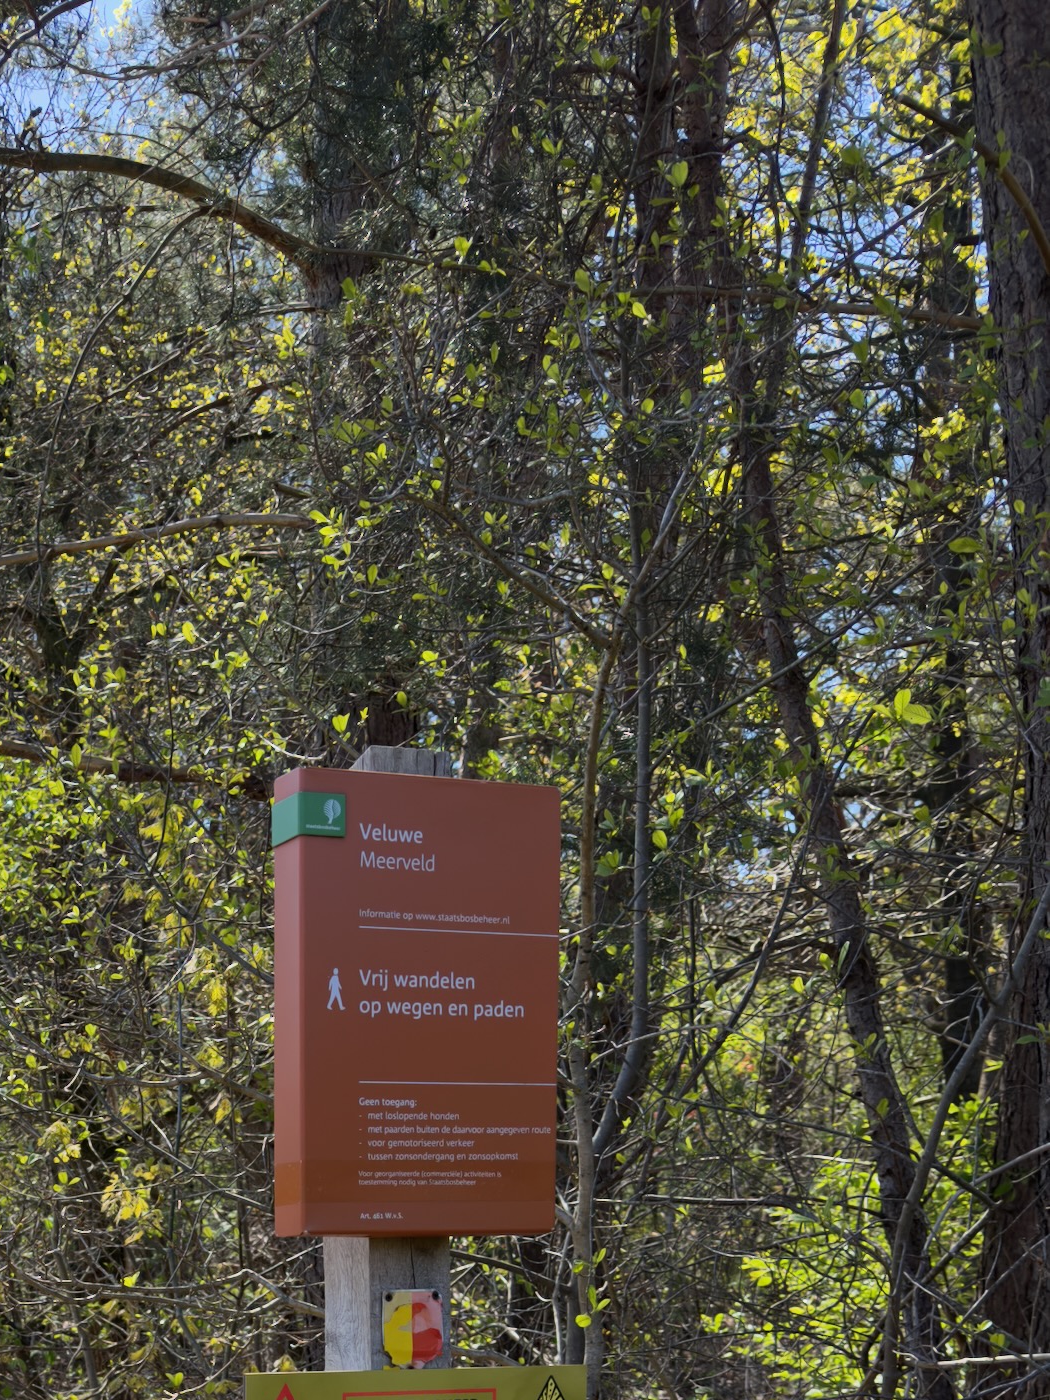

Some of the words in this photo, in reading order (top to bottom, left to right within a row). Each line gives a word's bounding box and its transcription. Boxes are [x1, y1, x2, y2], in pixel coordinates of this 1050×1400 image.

[360, 823, 423, 843] Veluwe
[360, 851, 435, 872] Meerveld
[359, 909, 401, 919] Informatie
[403, 911, 413, 921] op
[415, 913, 510, 925] www.staatsbosbeheer.nl
[359, 969, 388, 991] Vrij
[394, 972, 475, 990] wandelen
[359, 1000, 381, 1018] op
[387, 1002, 443, 1019] wegen
[448, 1003, 468, 1016] en
[474, 1001, 524, 1020] paden
[359, 1098, 380, 1106] Geen
[382, 1098, 417, 1108] toegang:
[385, 1112, 428, 1122] loslopende
[384, 1126, 415, 1135] paarden
[416, 1126, 439, 1134] buiten
[441, 1126, 450, 1134] de
[452, 1126, 484, 1134] daarvoor
[486, 1127, 530, 1136] aangegeven
[388, 1139, 444, 1149] gemotoriseerd
[395, 1153, 455, 1162] zonsondergang
[468, 1153, 518, 1162] zonsopkomst
